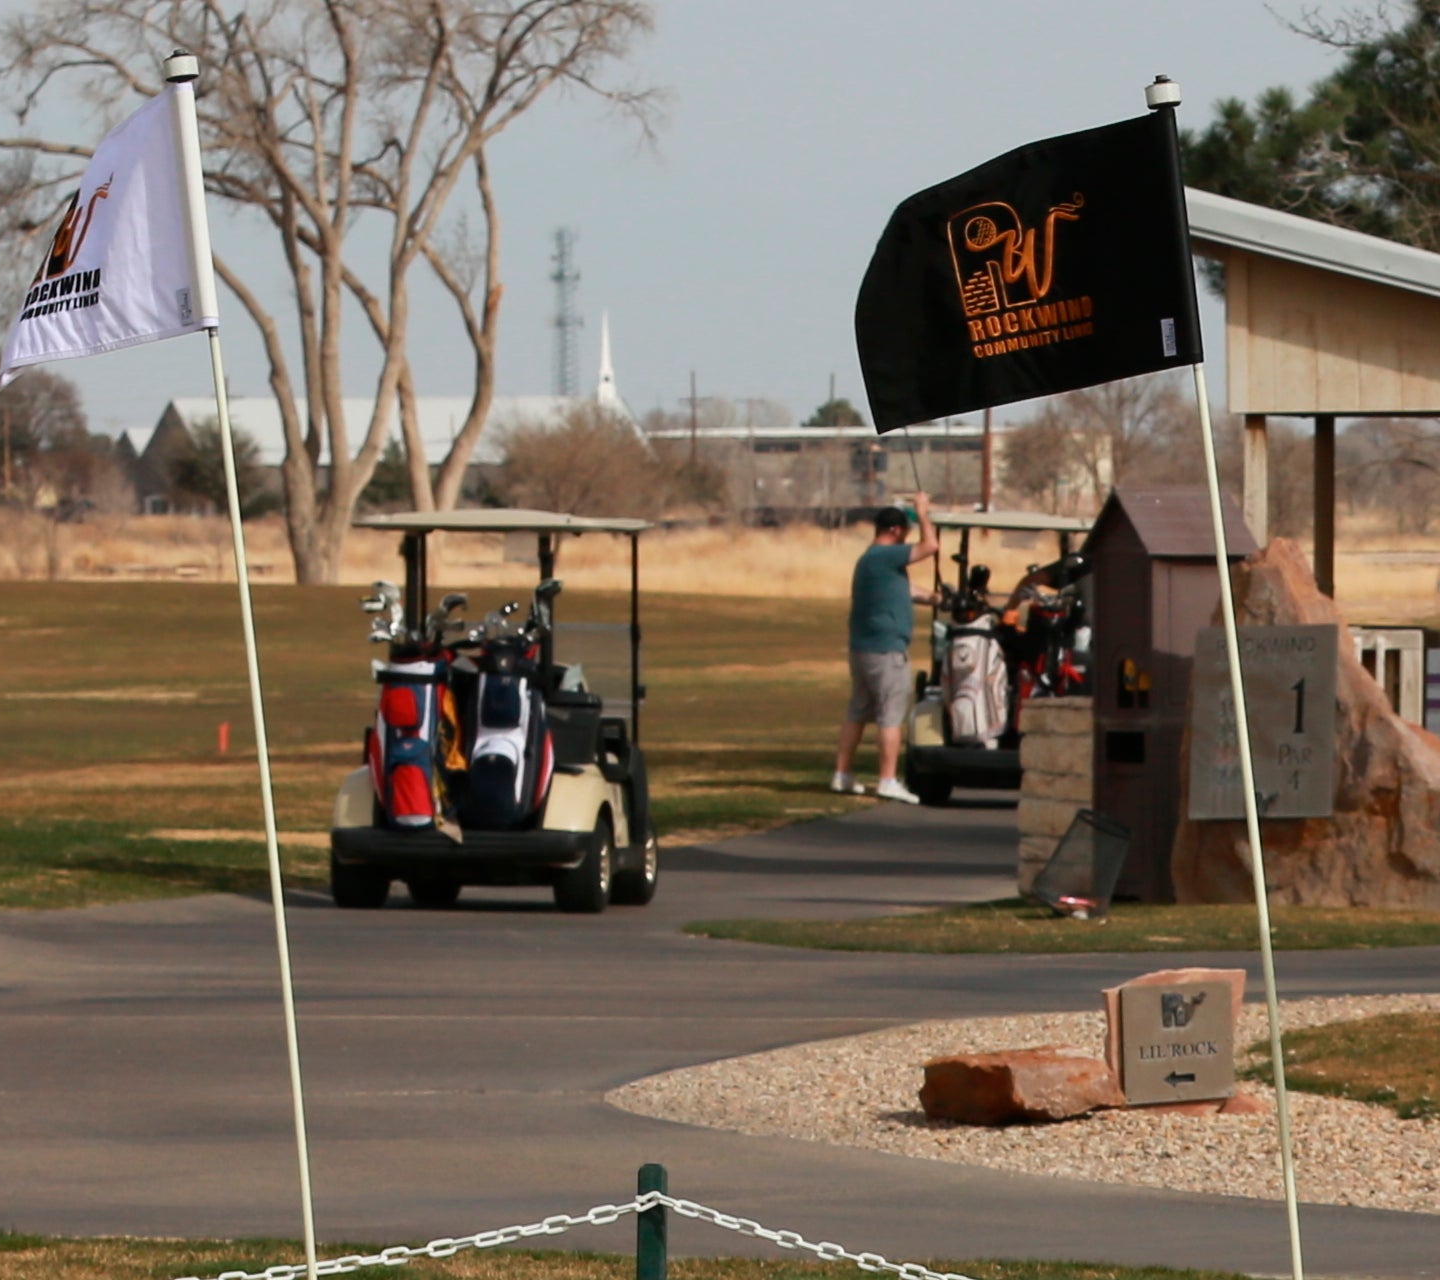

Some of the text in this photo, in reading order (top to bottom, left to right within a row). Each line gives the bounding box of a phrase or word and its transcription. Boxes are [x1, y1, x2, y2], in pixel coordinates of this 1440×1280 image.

[967, 295, 1093, 342] ROCKWIND
[973, 329, 1060, 359] COMMUNITY
[1216, 635, 1317, 653] RCKWIND
[1290, 677, 1305, 735] 1
